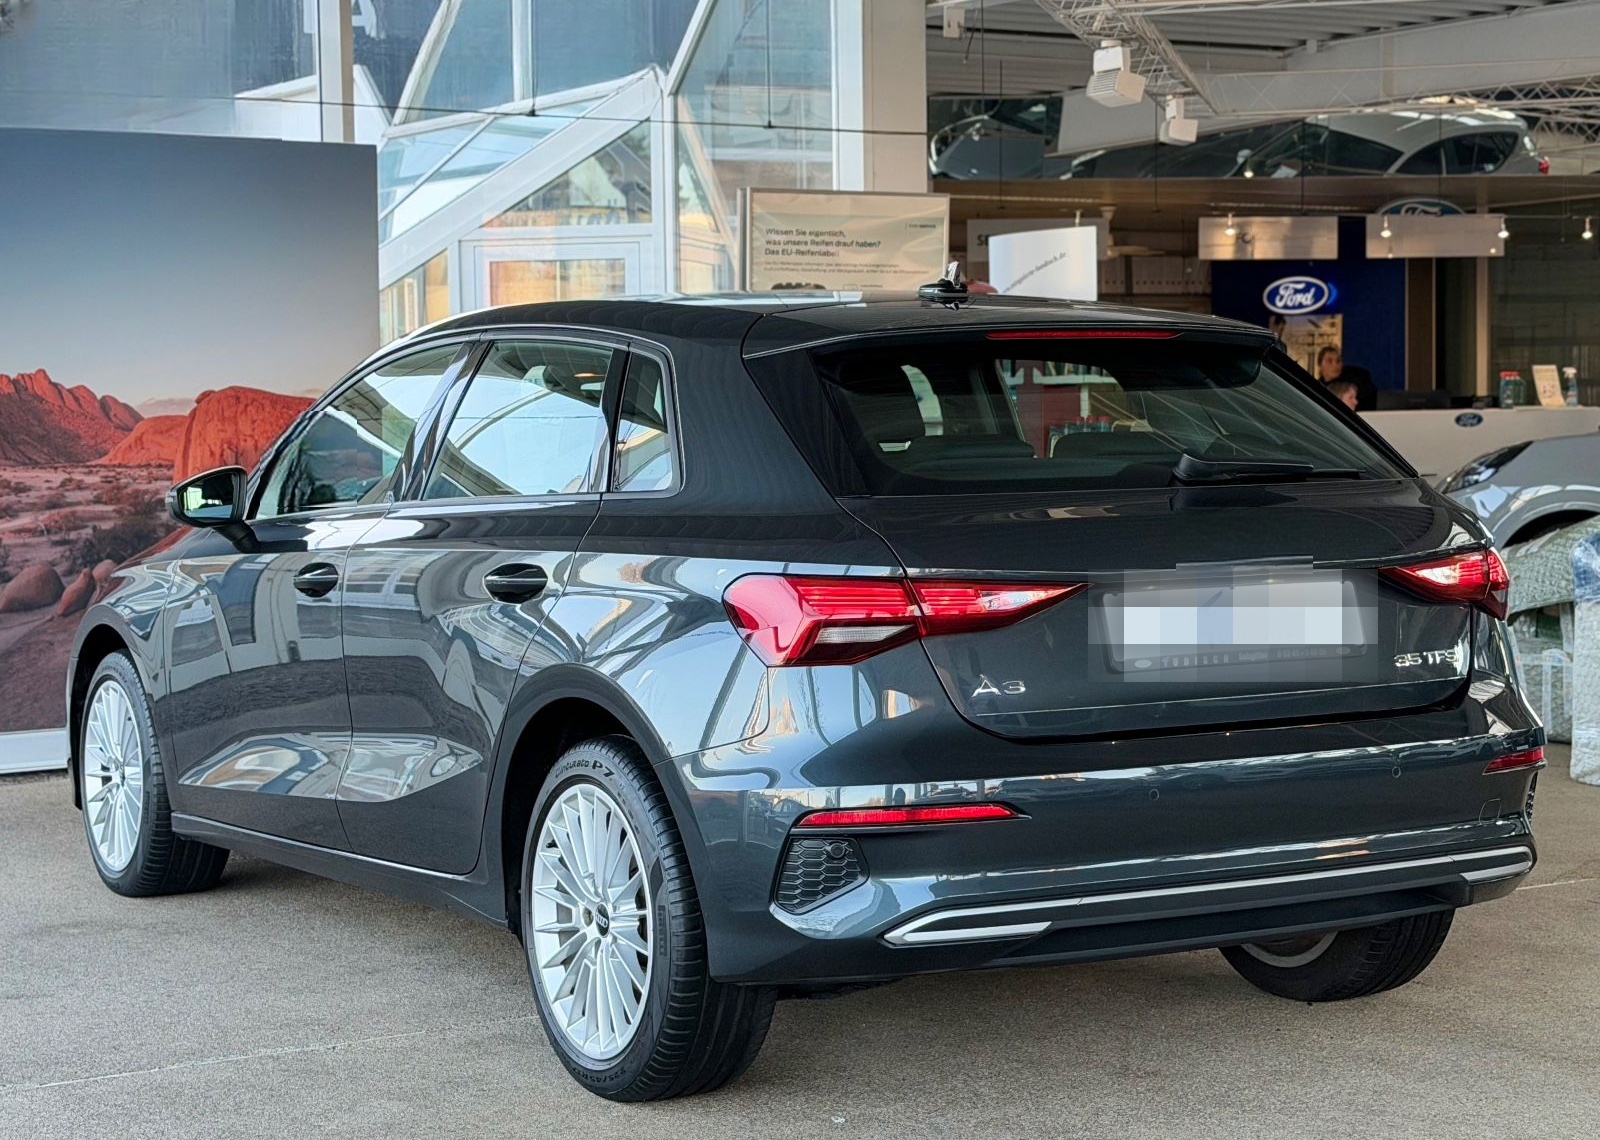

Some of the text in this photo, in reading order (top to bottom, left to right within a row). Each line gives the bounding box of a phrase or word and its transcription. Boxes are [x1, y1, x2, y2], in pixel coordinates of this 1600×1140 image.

[765, 228, 846, 238] Wissen Sie eigentlich,
[782, 239, 809, 247] unsere
[810, 239, 834, 247] Reifen
[834, 240, 855, 248] drauf
[855, 240, 881, 249] haben?
[764, 248, 780, 256] Das
[1275, 282, 1315, 308] Ford
[1458, 414, 1479, 425] Ford
[1394, 652, 1423, 667] 35
[971, 674, 1026, 698] A3
[592, 760, 615, 778] P7
